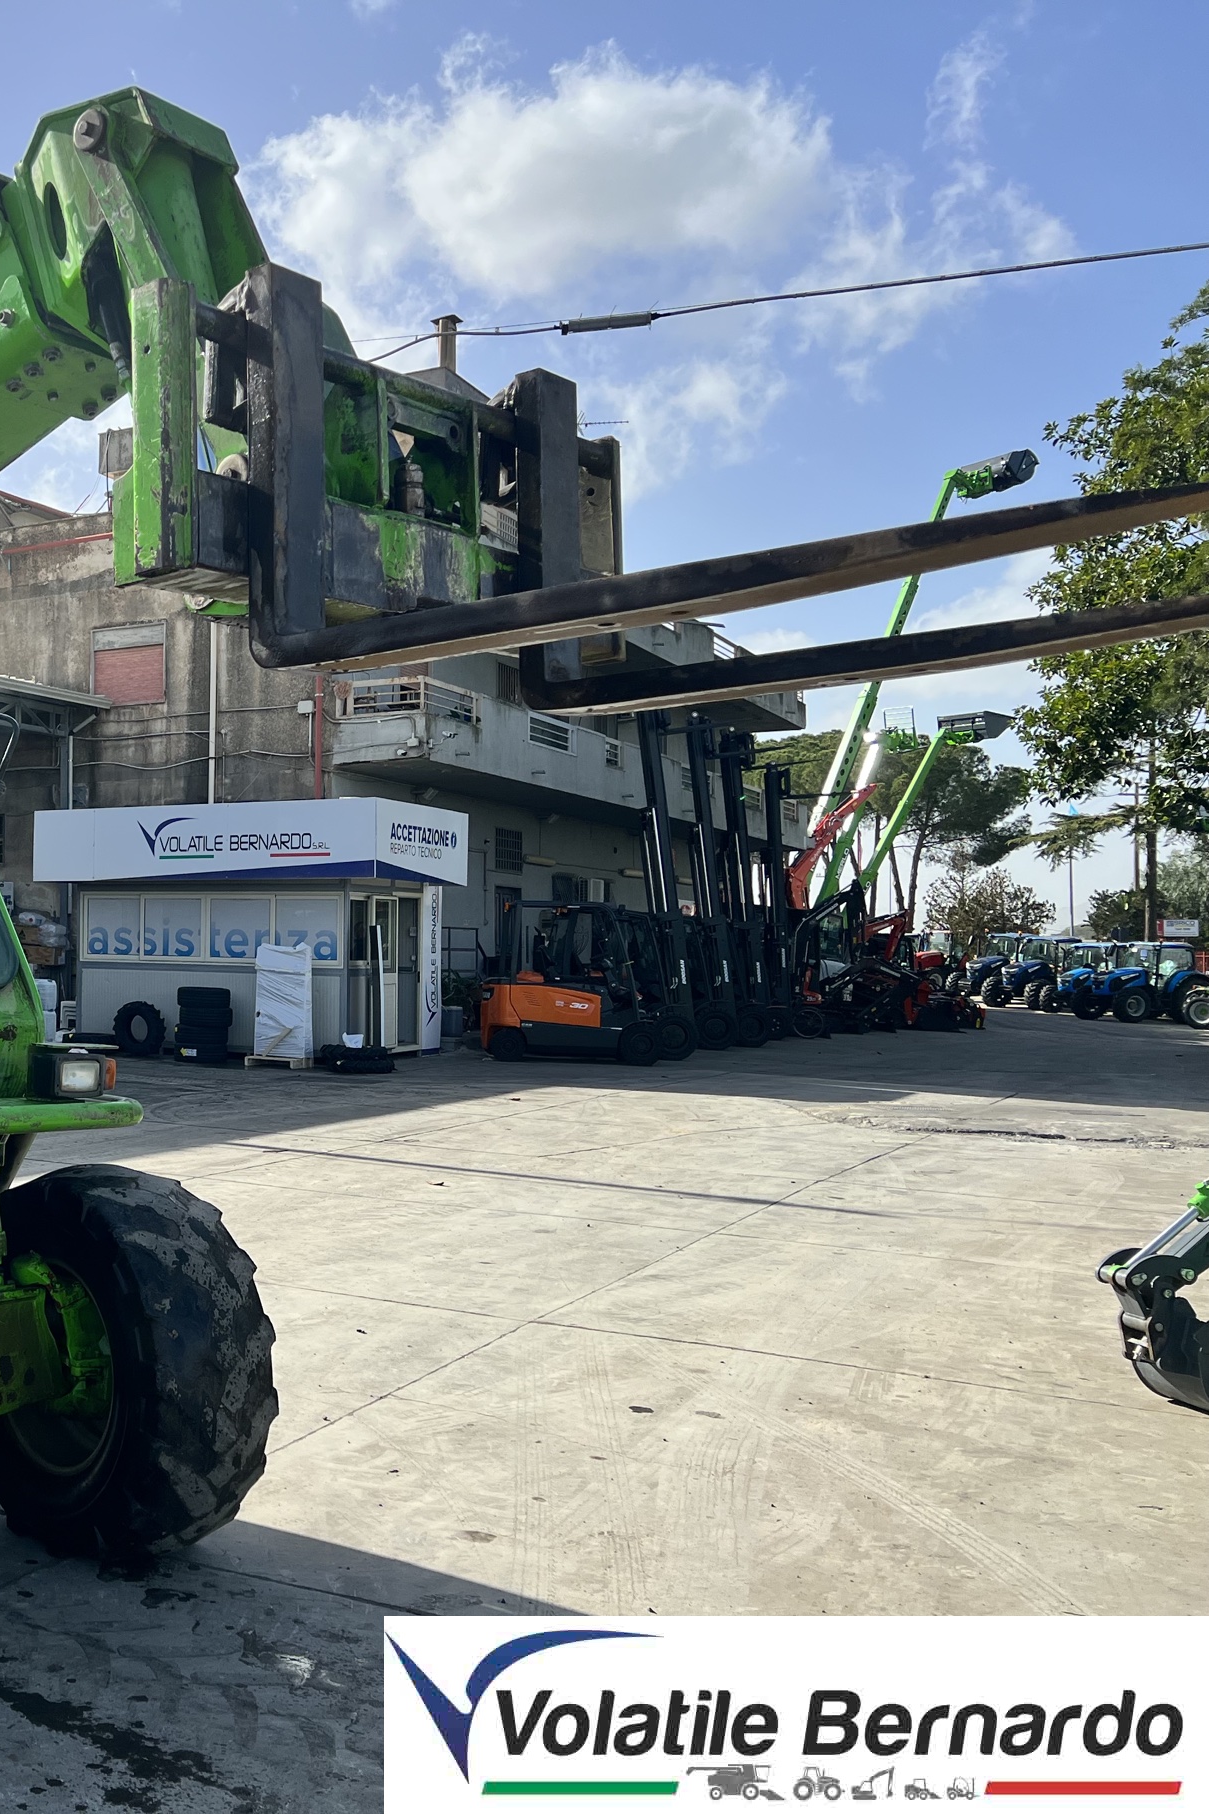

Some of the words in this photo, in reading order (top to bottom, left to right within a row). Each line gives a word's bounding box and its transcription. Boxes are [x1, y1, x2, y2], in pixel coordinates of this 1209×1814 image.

[159, 835, 224, 853] VOLATILE
[229, 832, 312, 852] BERNARDO
[390, 822, 450, 847] ACCETTAZIONE
[390, 842, 416, 857] REPARTO
[418, 846, 443, 860] TECNICO
[88, 918, 338, 960] assistenza
